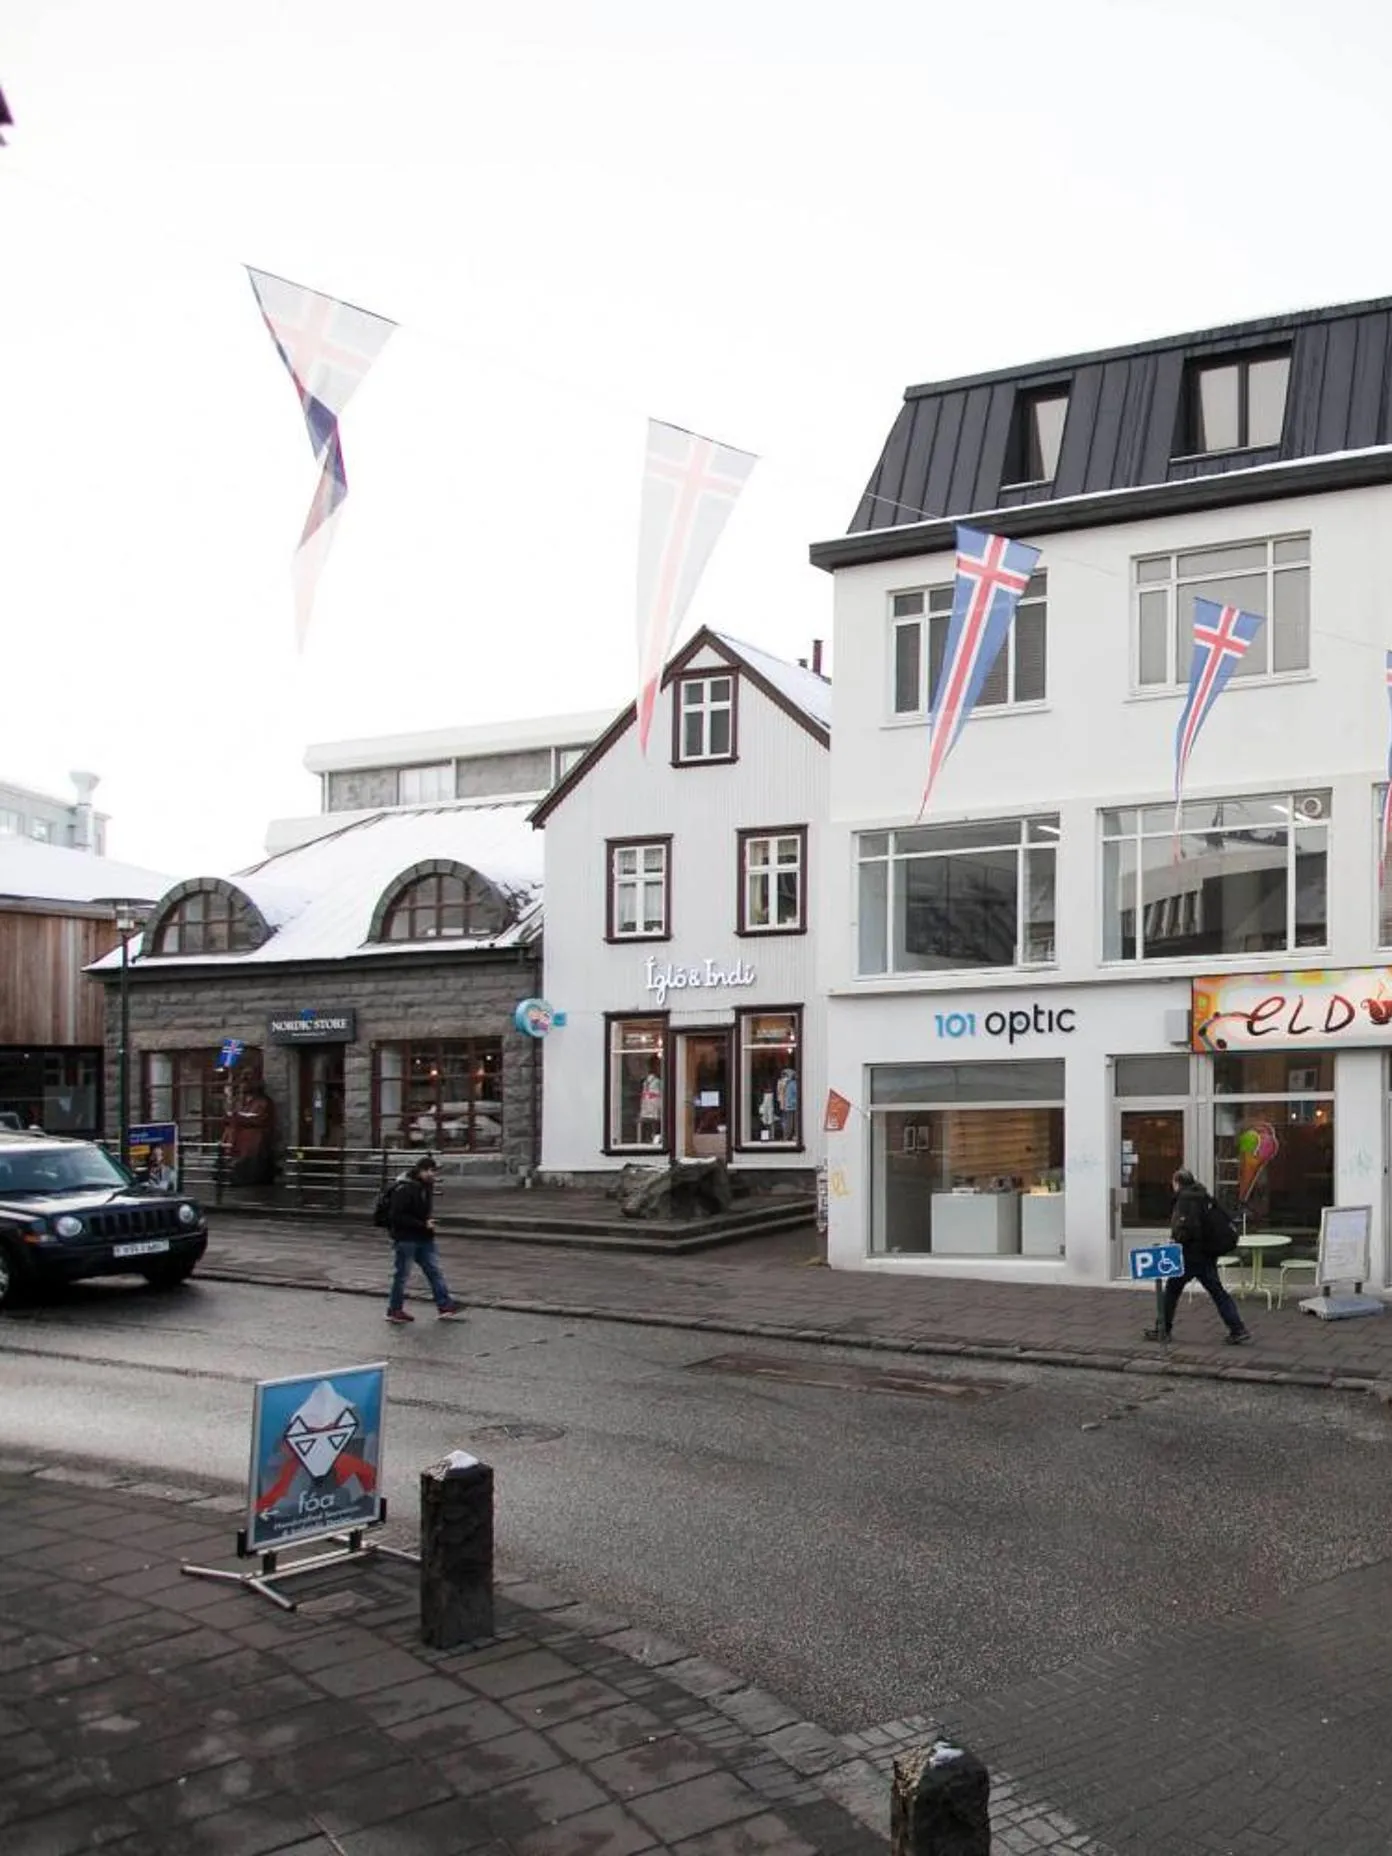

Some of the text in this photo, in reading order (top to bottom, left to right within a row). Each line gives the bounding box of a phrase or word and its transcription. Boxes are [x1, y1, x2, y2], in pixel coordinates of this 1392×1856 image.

[272, 1018, 348, 1032] NORDIC STORE
[934, 1003, 1076, 1045] 101 optic
[1136, 1252, 1154, 1277] P
